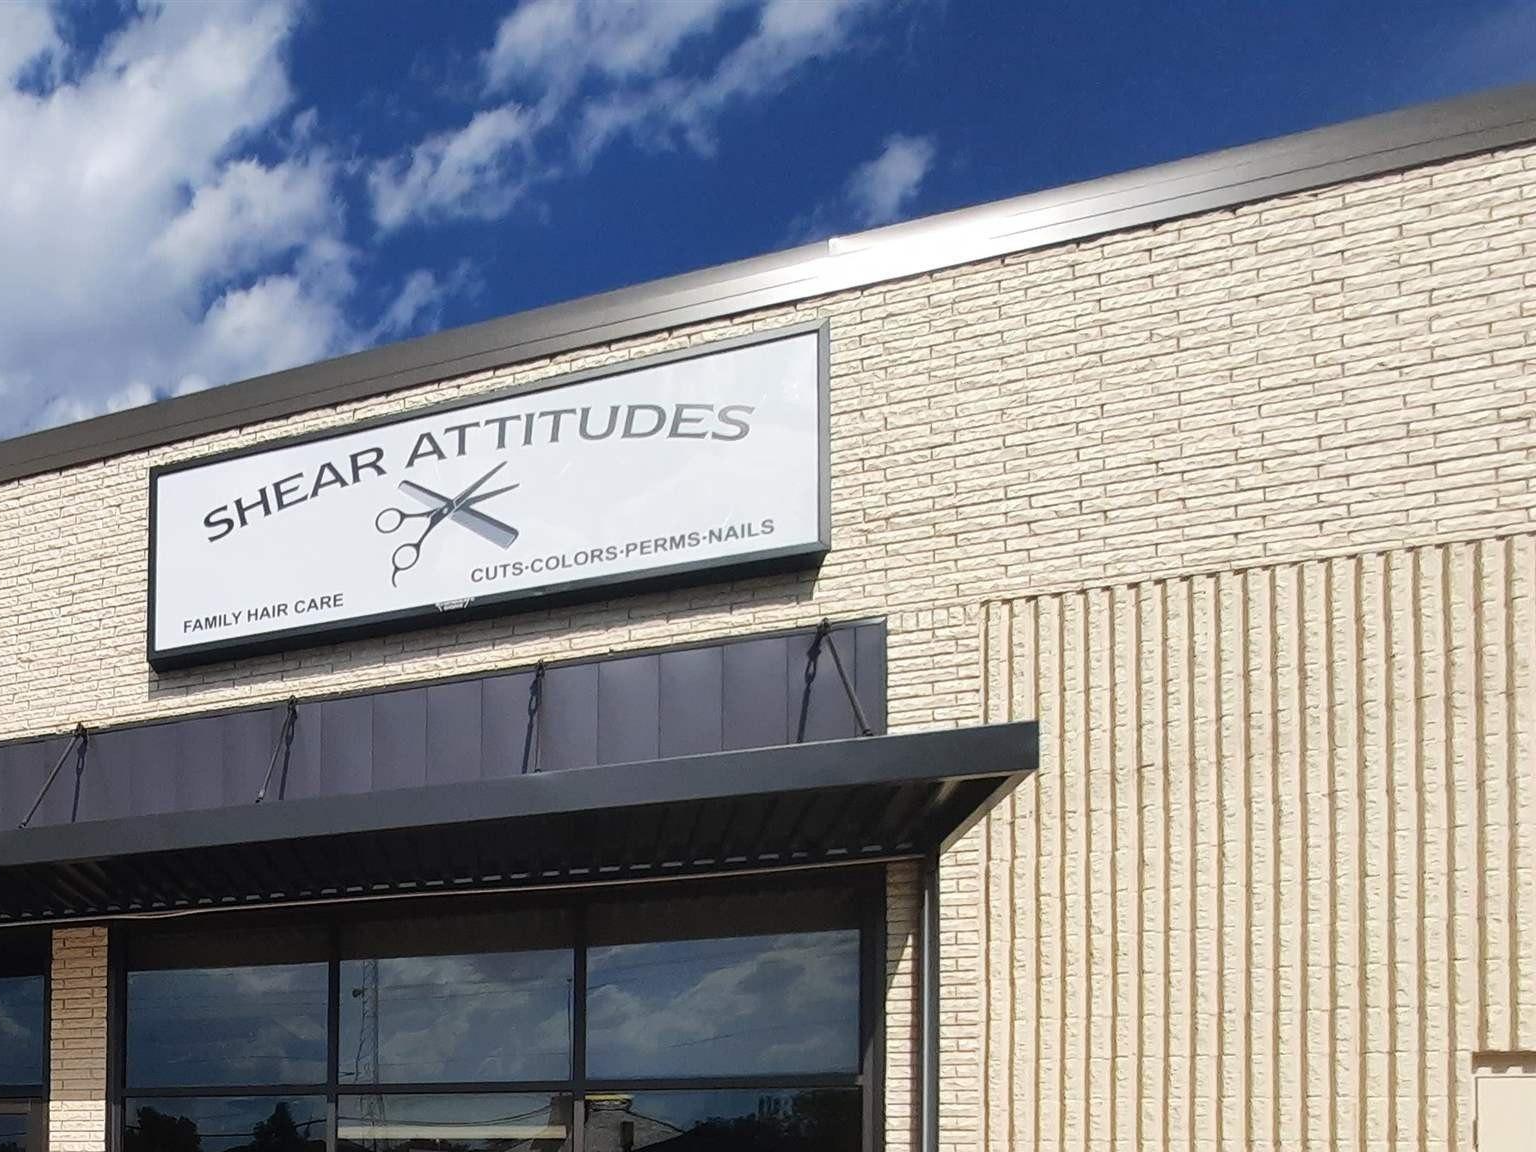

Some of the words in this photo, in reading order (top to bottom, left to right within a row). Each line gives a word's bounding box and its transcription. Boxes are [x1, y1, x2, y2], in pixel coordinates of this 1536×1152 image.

[203, 447, 387, 542] SHEAR
[405, 403, 755, 469] ATTITUDES
[183, 611, 242, 633] FAMILY
[247, 603, 289, 622] HAIR
[294, 593, 344, 614] CARE
